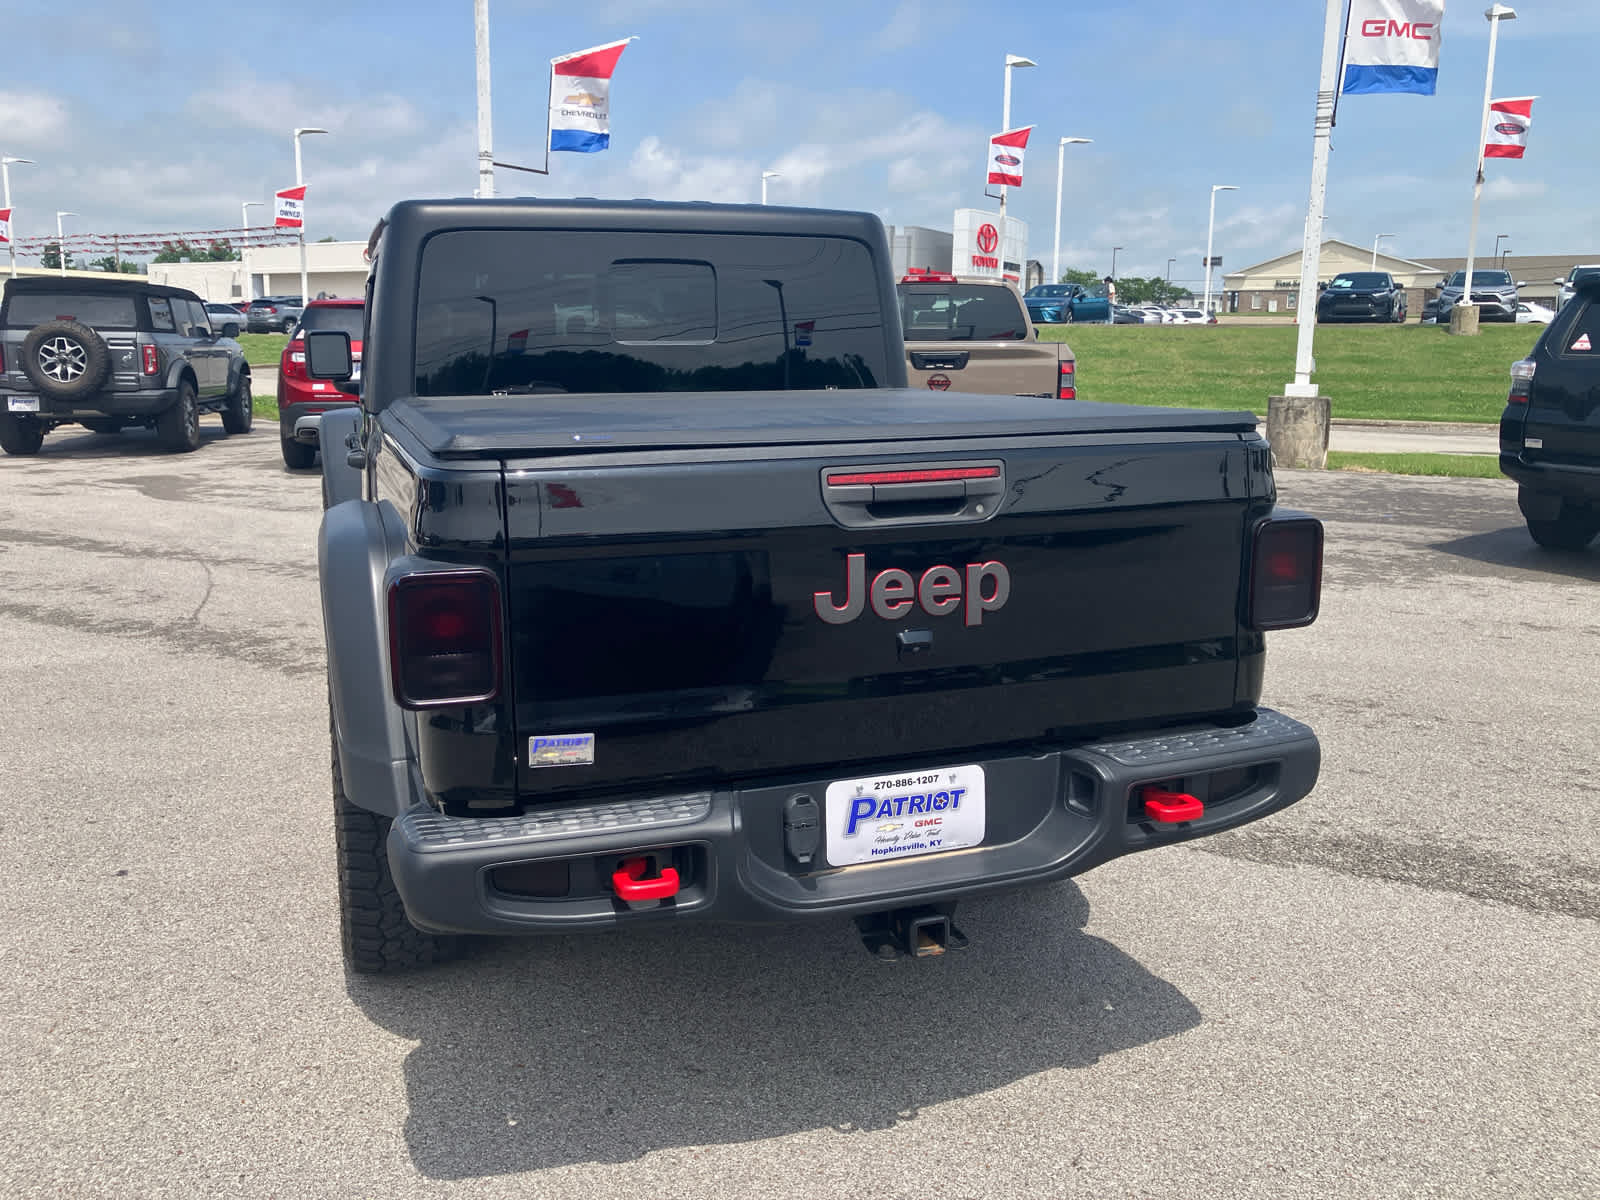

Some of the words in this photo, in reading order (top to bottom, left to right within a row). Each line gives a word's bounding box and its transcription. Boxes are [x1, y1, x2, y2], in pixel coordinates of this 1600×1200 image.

[1362, 19, 1433, 40] GMC
[279, 209, 300, 218] OWNED
[971, 255, 999, 269] TOYOTA
[814, 553, 1010, 626] Jeep
[874, 774, 940, 791] 270-886-1207
[847, 789, 966, 834] PATRIOT
[914, 817, 943, 828] GMC
[871, 842, 927, 856] Hopkinsville,
[929, 839, 943, 847] KY
